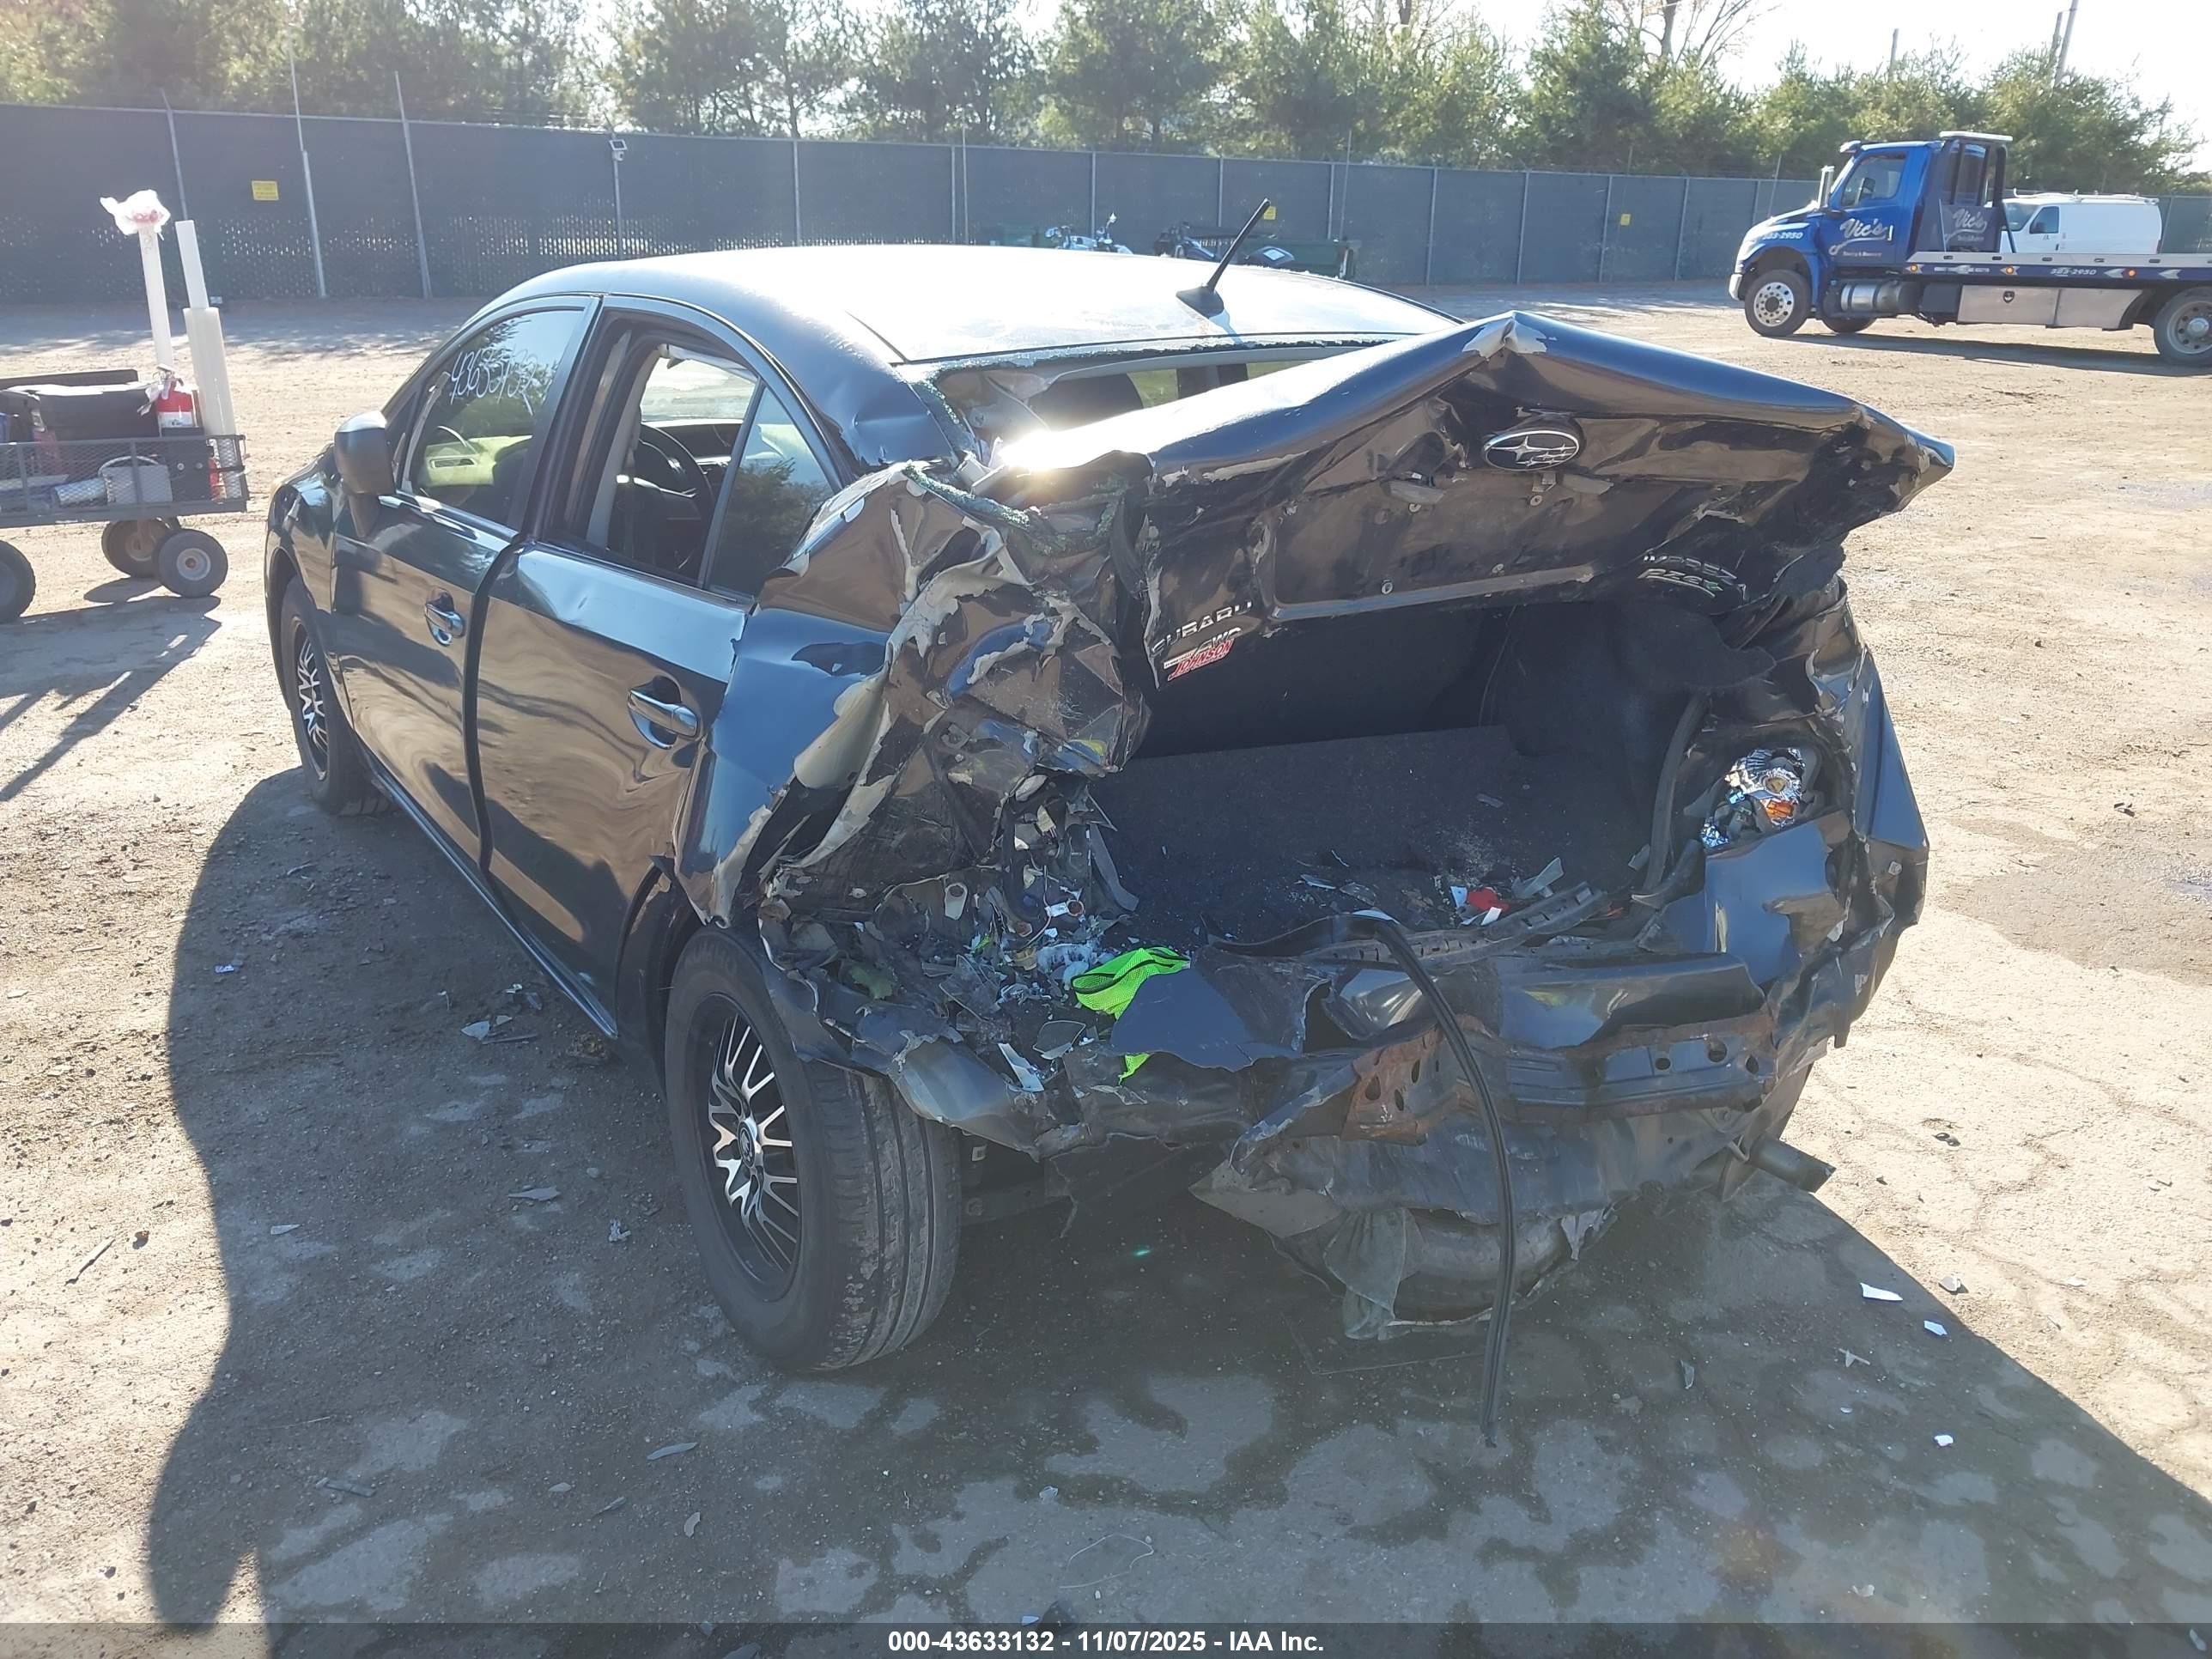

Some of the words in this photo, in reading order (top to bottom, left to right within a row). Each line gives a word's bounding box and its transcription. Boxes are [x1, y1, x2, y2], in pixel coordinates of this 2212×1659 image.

[1838, 217, 1887, 240] Vic's
[1150, 600, 1252, 658] SUBARU
[1168, 638, 1235, 680] JOHNSON
